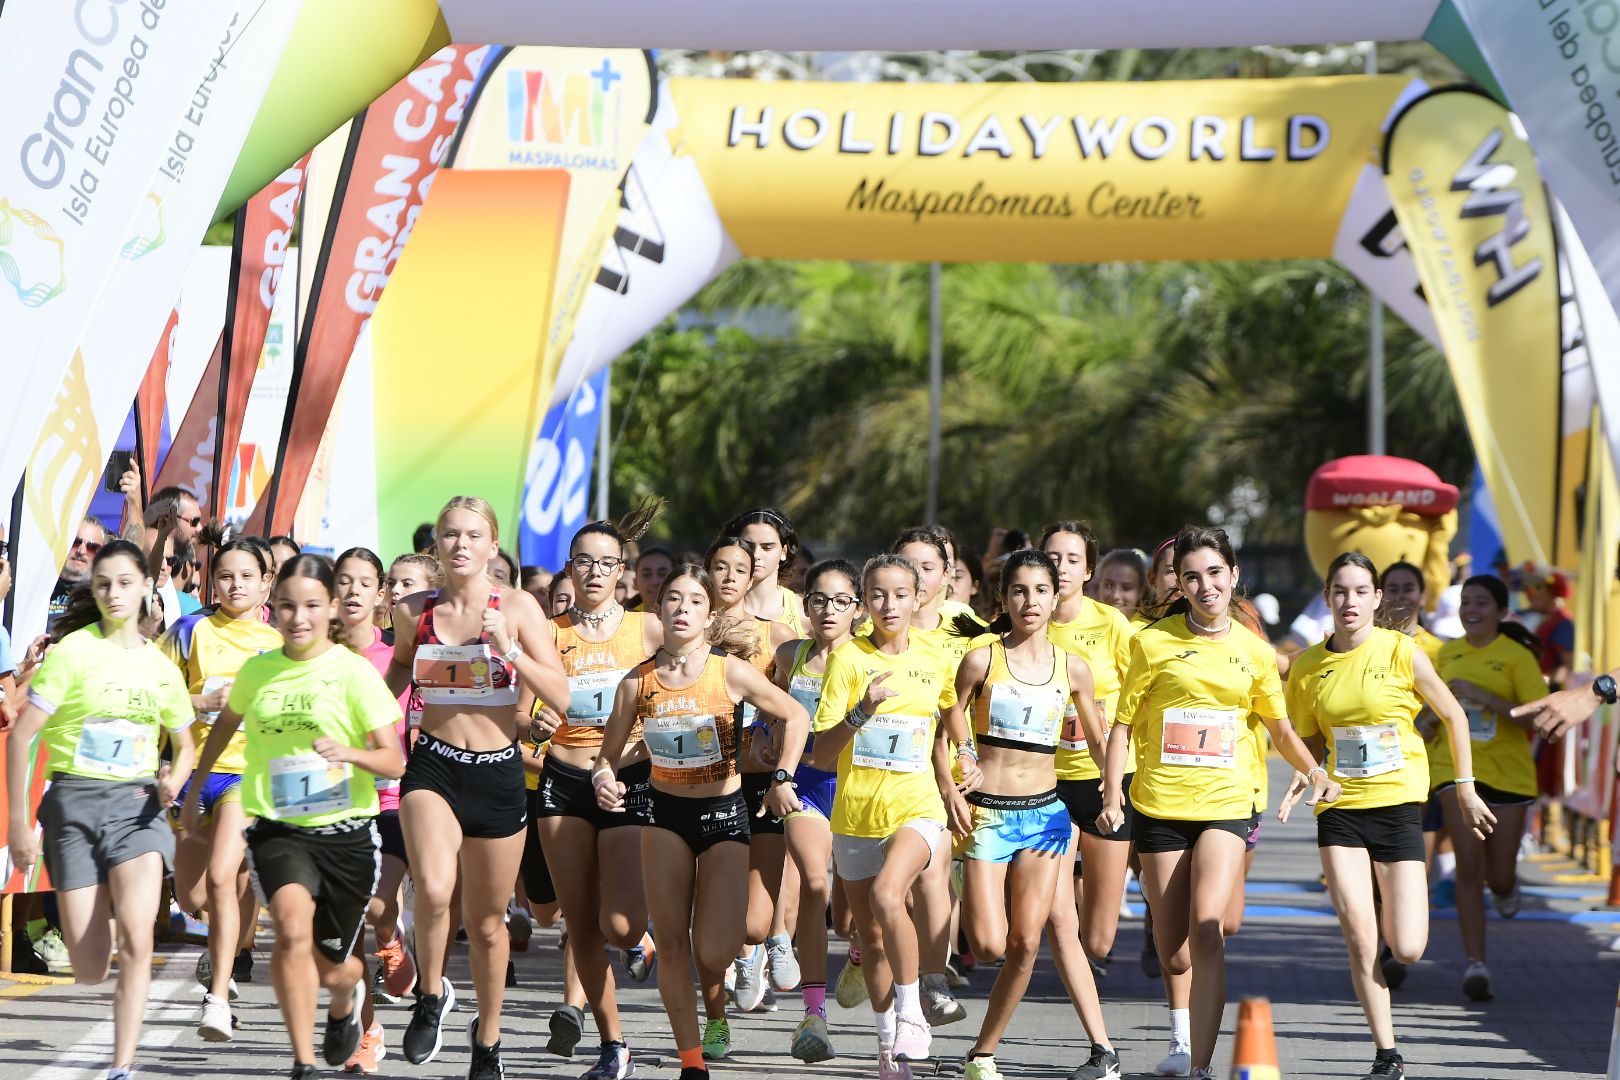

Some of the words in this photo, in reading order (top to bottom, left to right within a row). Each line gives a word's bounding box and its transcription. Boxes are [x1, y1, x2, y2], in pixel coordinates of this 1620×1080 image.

[20, 48, 104, 190] Gran
[62, 168, 99, 226] Isla
[84, 35, 149, 166] Europea
[508, 151, 619, 171] MASPALOMAS
[845, 178, 1073, 223] Maspalomas
[1087, 182, 1206, 219] Center
[345, 154, 421, 314] GRAN
[446, 664, 457, 683] 1
[593, 691, 603, 712] 1
[1022, 705, 1033, 725] 1
[1067, 719, 1077, 737] 1
[1197, 728, 1208, 749] 1
[111, 738, 124, 758] 1
[430, 740, 476, 764] NIKE
[475, 747, 515, 765] PRO
[673, 734, 684, 754] 1
[888, 733, 900, 754] 1
[1358, 743, 1368, 763] 1
[300, 774, 311, 797] 1
